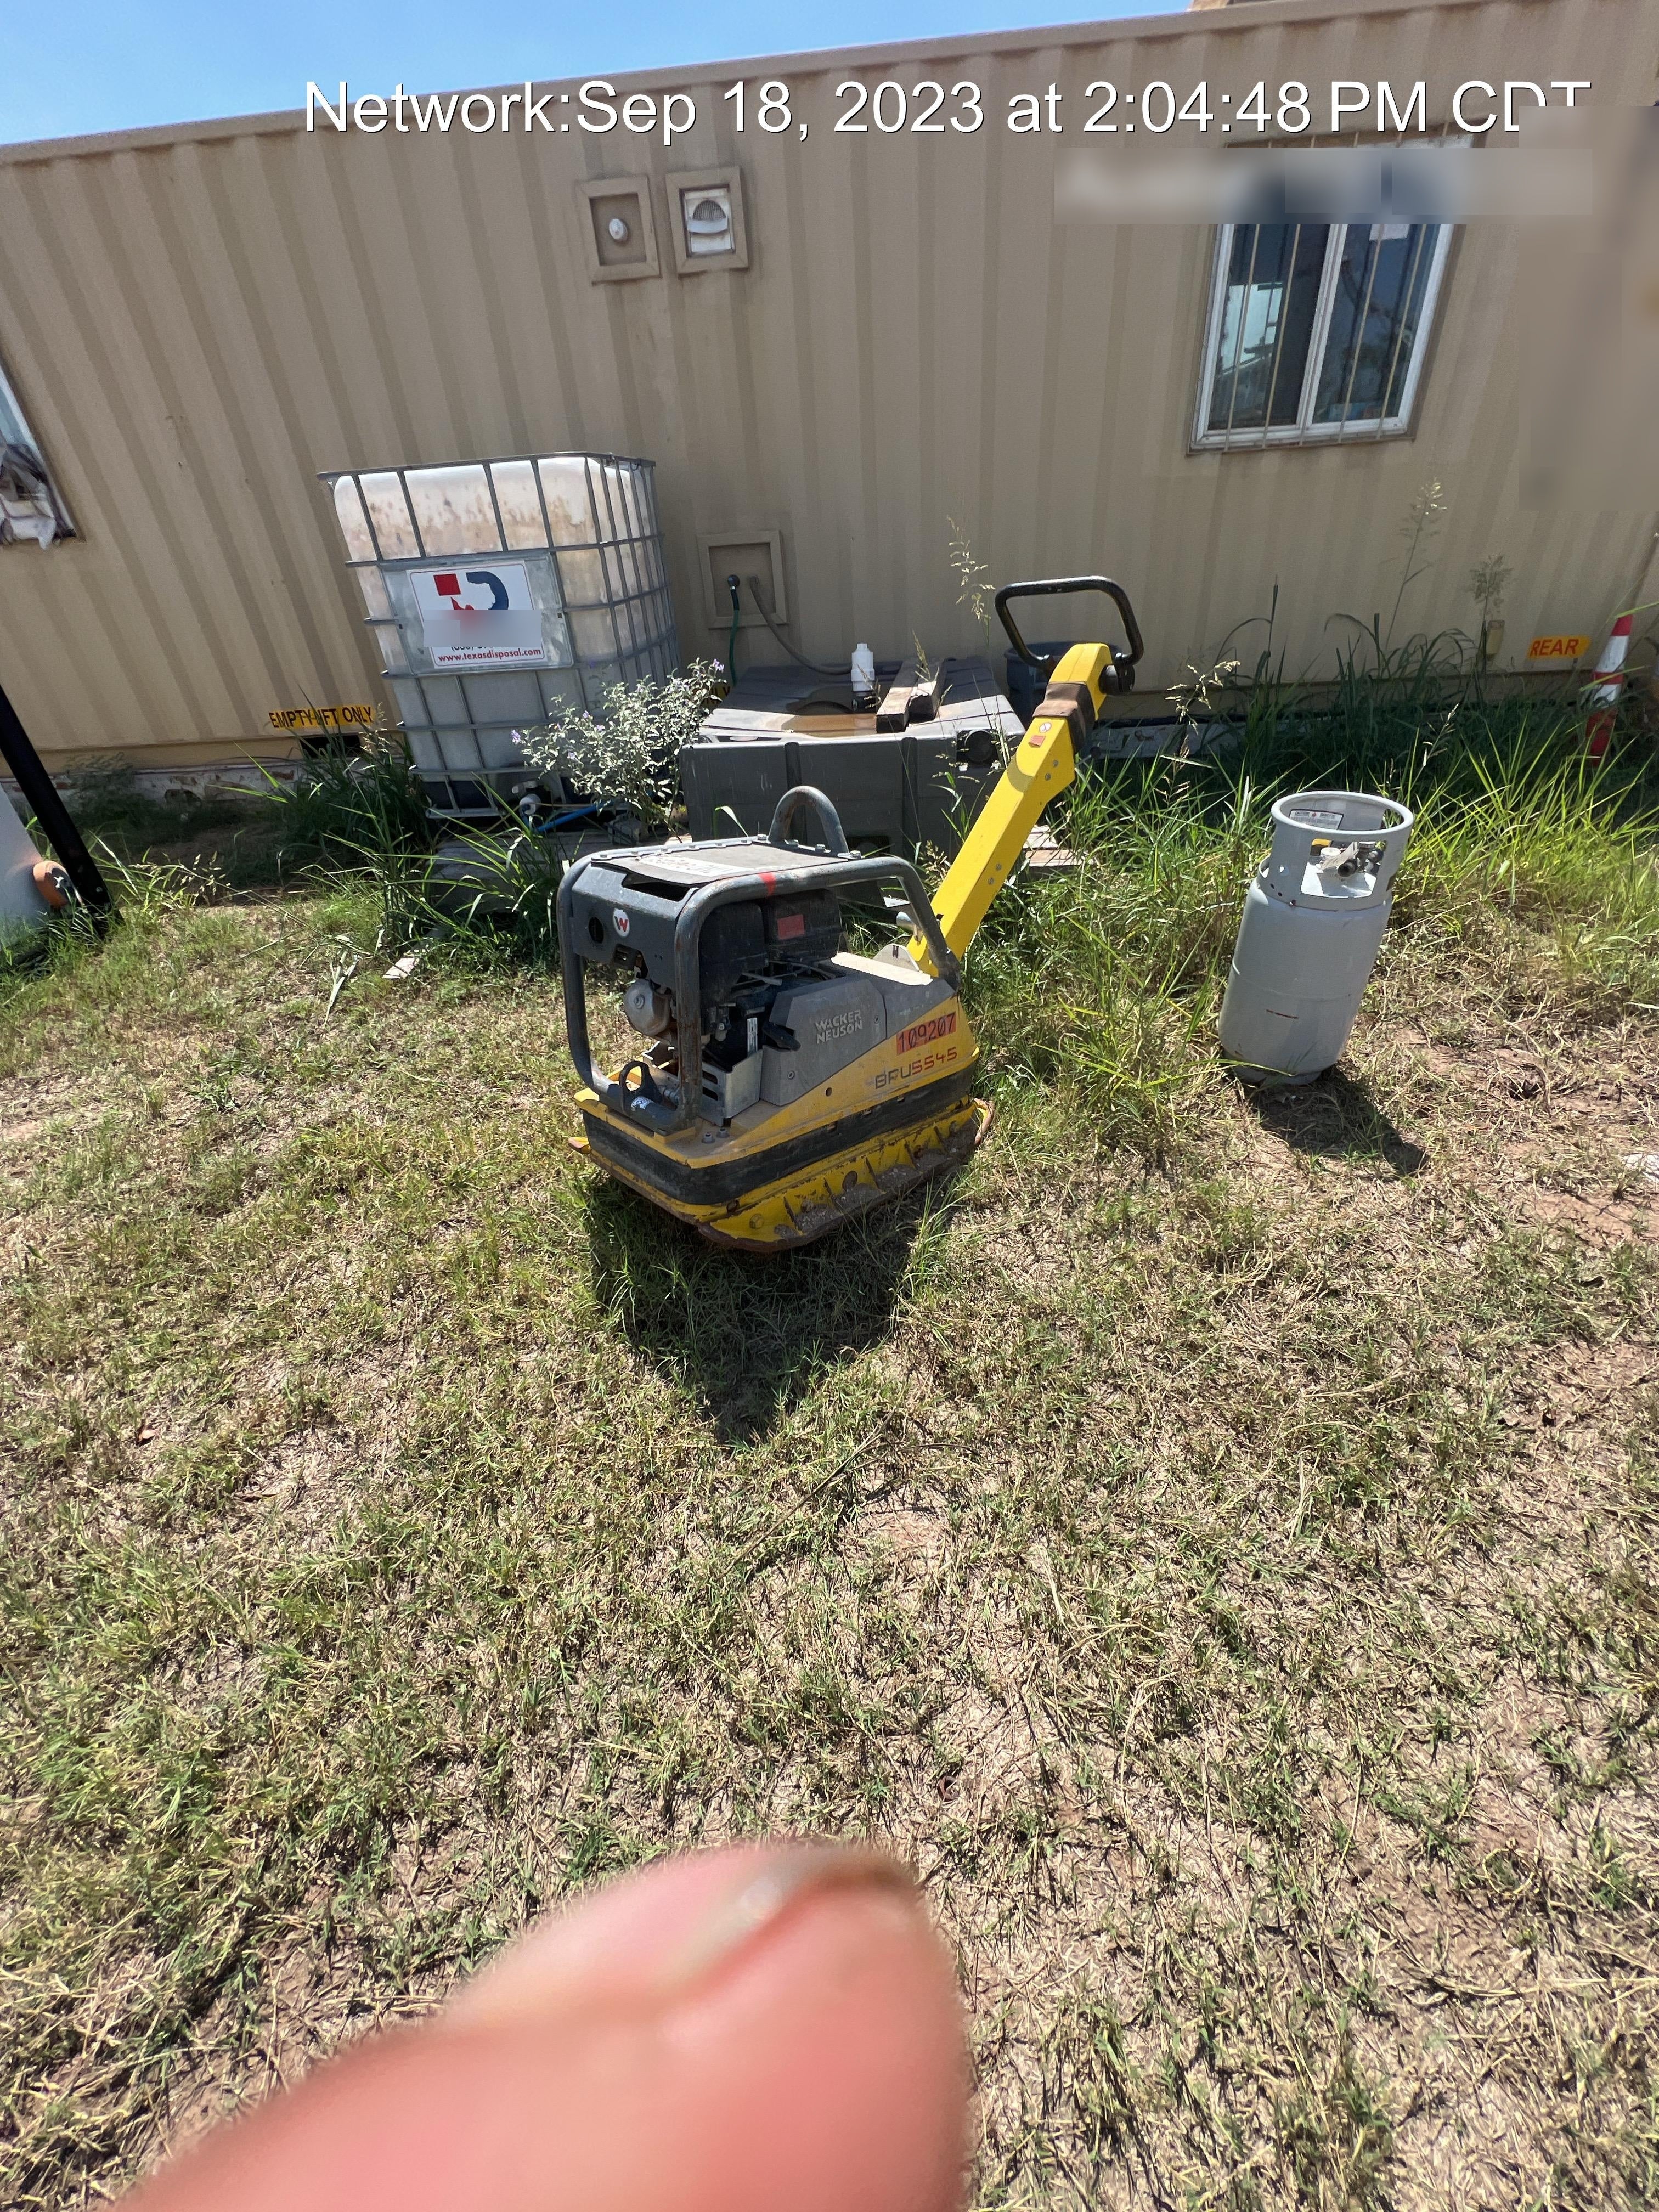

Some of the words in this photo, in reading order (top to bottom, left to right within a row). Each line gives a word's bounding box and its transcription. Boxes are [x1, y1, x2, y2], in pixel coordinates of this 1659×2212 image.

[438, 648, 541, 662] www.texasdisposal.com
[1530, 639, 1579, 657] REAR
[269, 709, 313, 728] EMPTY
[342, 706, 373, 723] ONLY
[814, 1009, 861, 1032] WACKER
[816, 1020, 864, 1045] NEUSON
[899, 1012, 956, 1052] 109207
